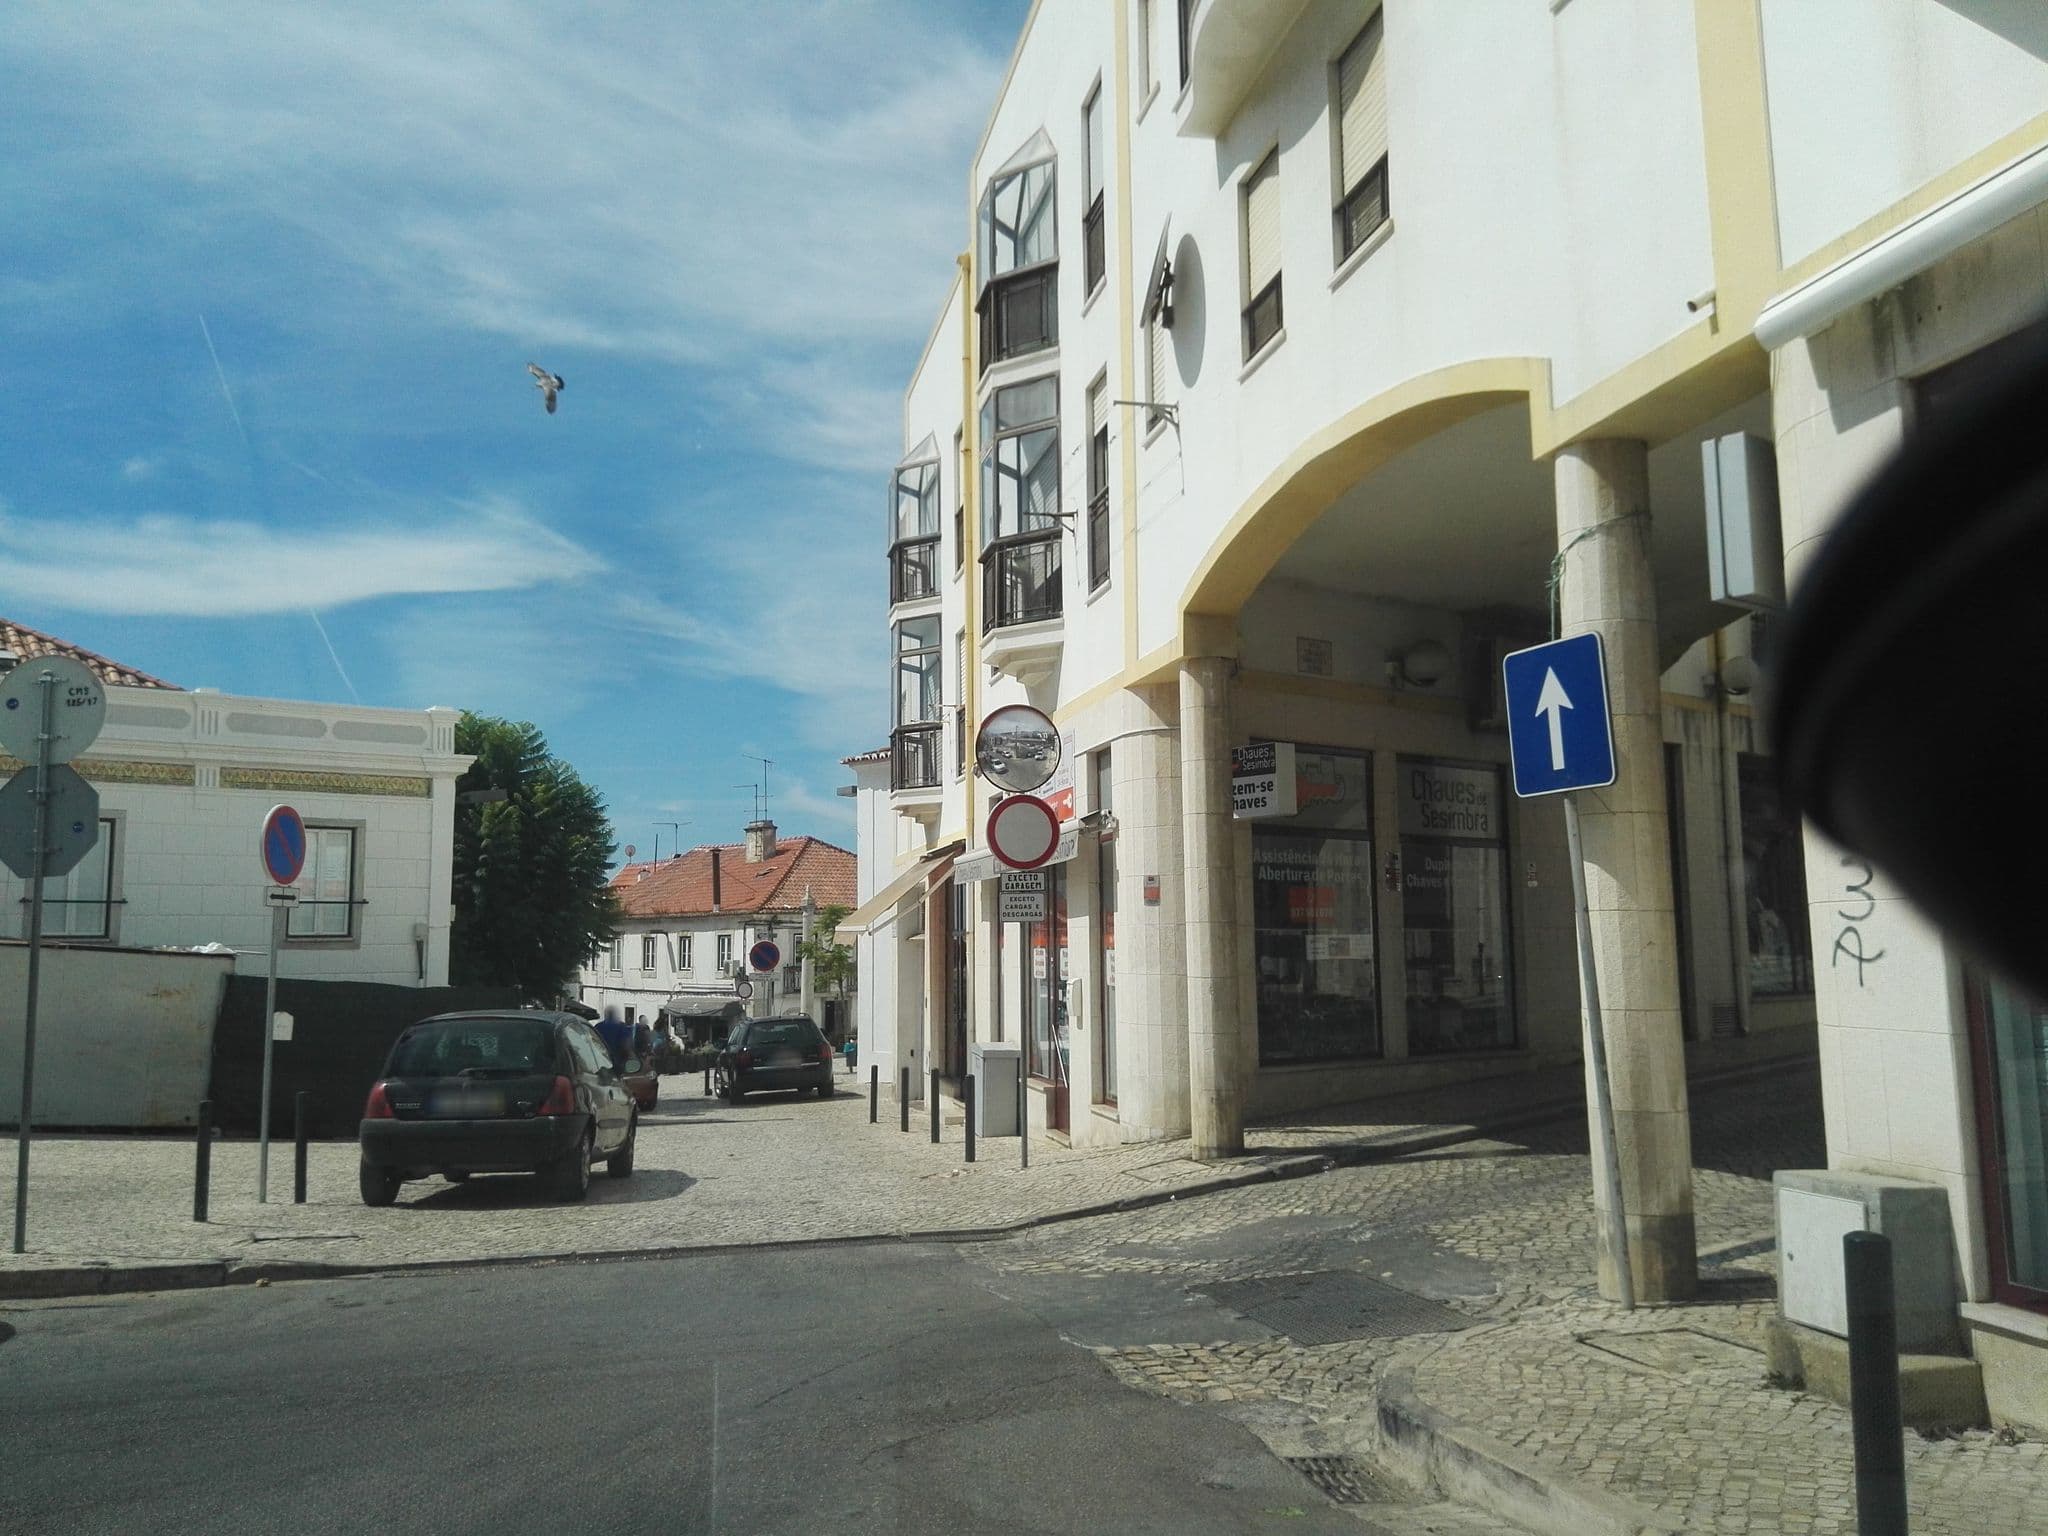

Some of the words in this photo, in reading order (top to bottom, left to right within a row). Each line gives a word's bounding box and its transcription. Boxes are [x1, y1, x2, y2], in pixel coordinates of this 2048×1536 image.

[1242, 758, 1276, 771] Sesimbra
[1421, 803, 1489, 832] Sesimbra
[1258, 866, 1312, 882] Abertura
